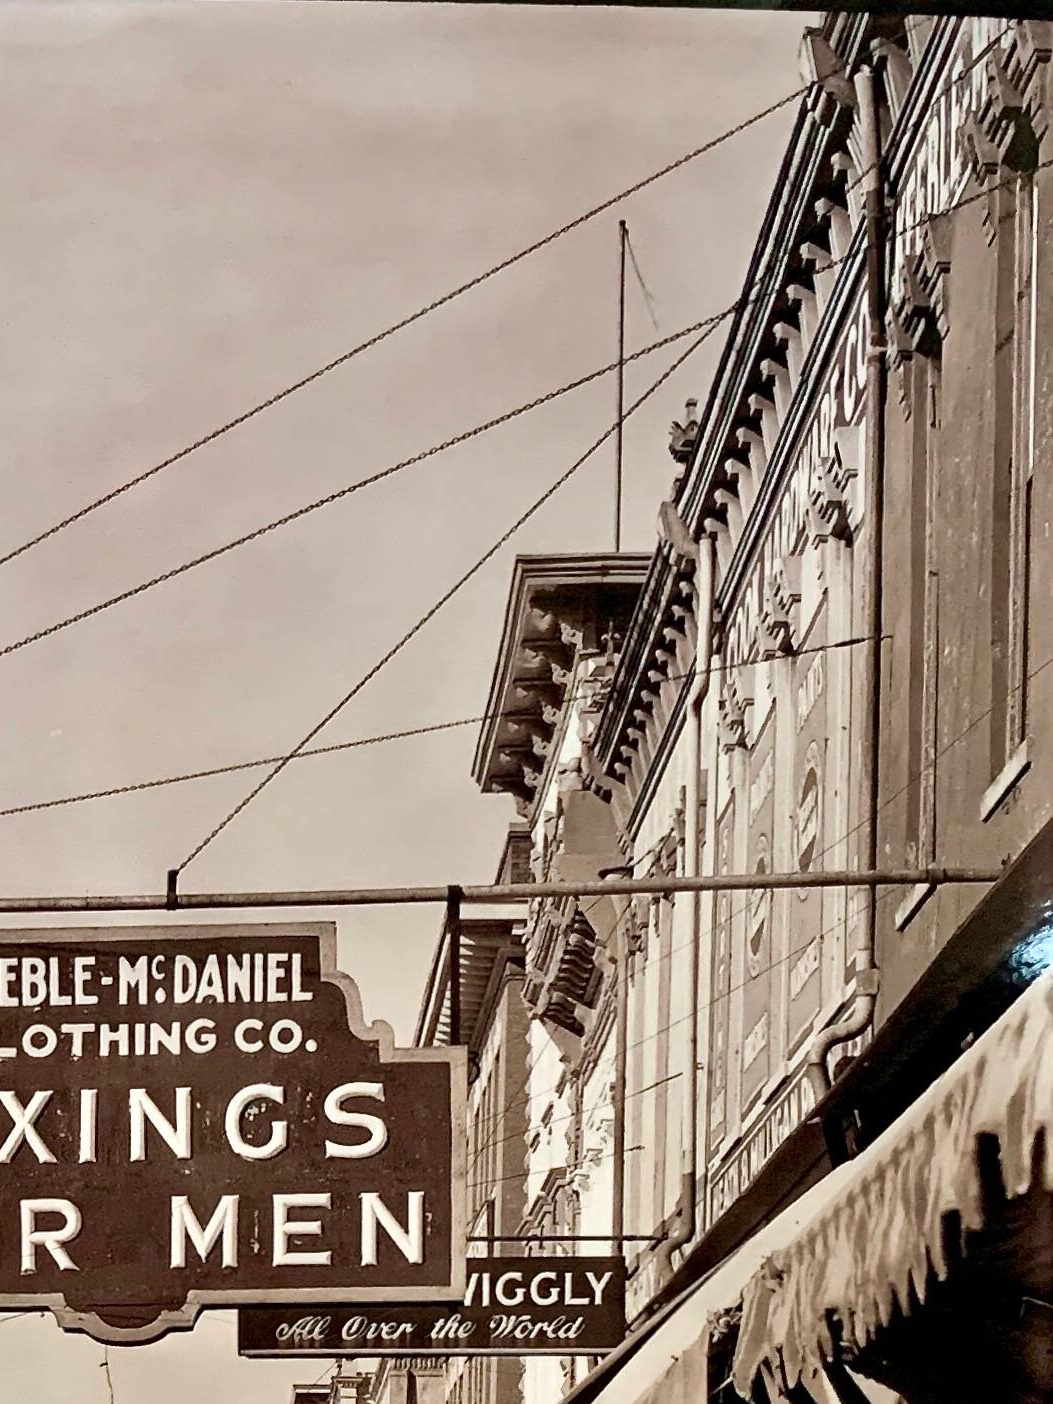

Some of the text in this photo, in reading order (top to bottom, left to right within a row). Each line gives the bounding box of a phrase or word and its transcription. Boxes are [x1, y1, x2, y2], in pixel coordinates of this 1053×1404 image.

[235, 1018, 318, 1054] CO.
[170, 1190, 428, 1270] MEN
[276, 1313, 586, 1341] All Over the World
